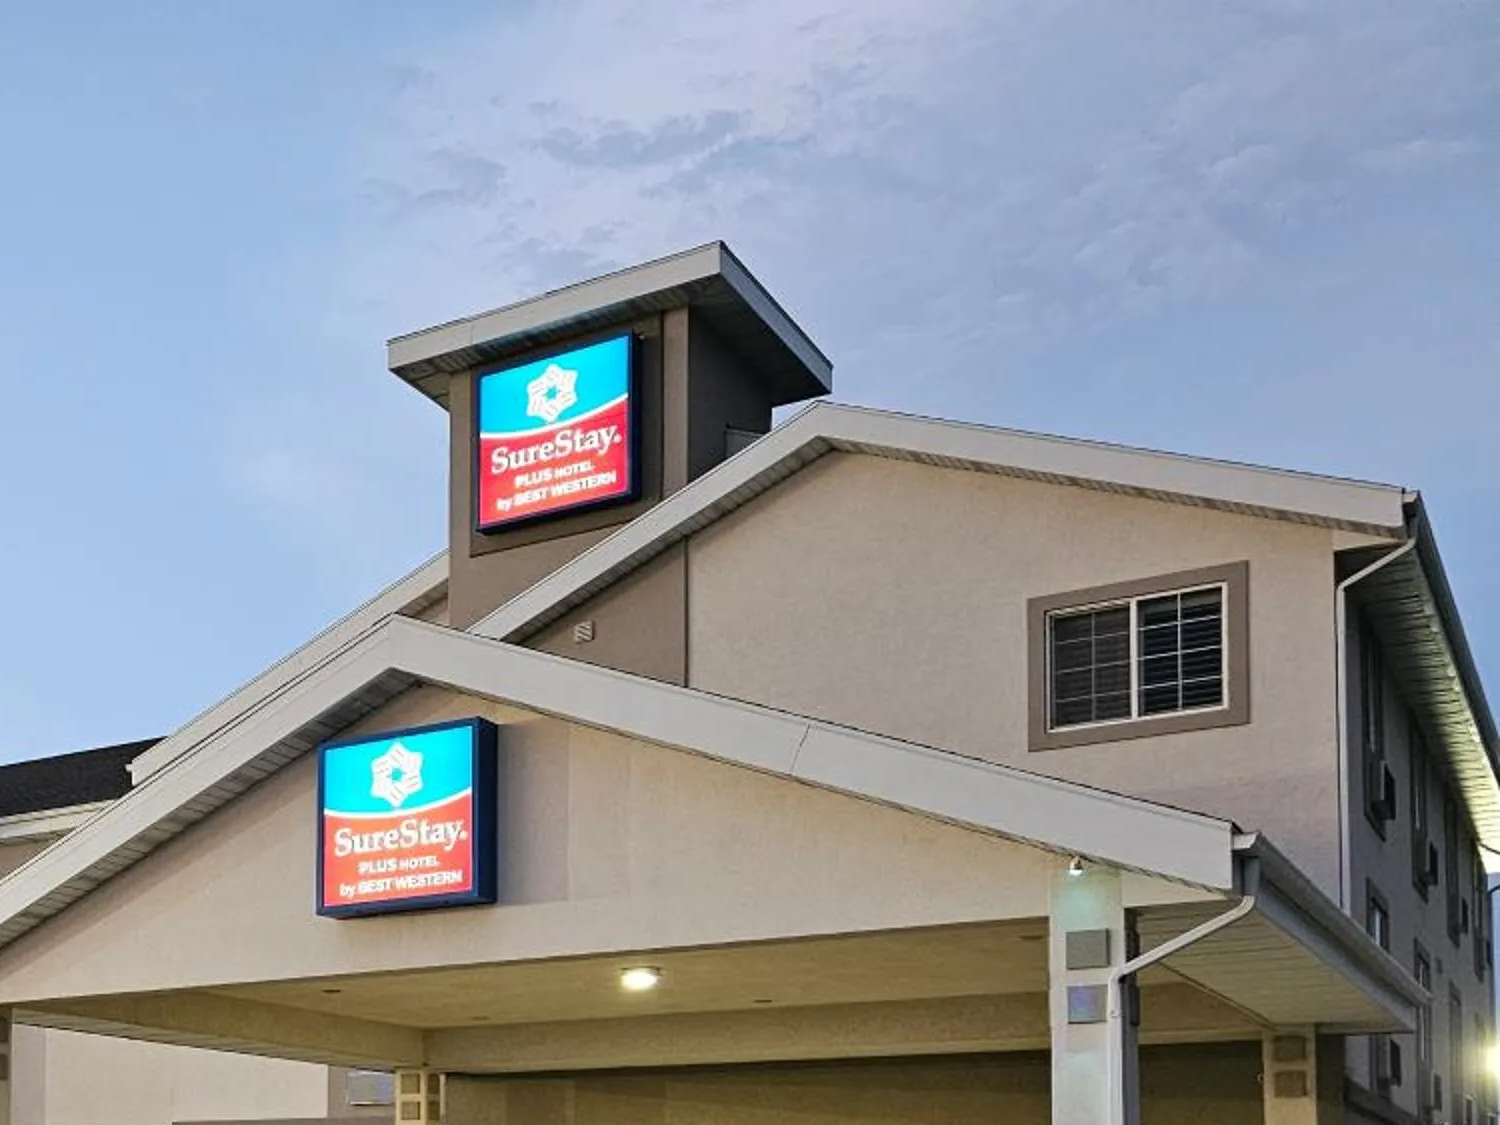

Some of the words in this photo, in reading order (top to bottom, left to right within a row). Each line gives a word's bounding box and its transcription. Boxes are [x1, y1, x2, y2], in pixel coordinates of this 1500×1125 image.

[515, 468, 551, 487] PLUS
[554, 460, 594, 477] HOTEL
[496, 497, 513, 512] by
[514, 488, 549, 506] BEST
[550, 471, 616, 496] WESTERN
[358, 858, 398, 874] PLUS
[399, 855, 439, 870] HOTEL
[339, 881, 355, 898] by
[358, 876, 393, 895] BEST
[394, 869, 463, 890] WESTERN
